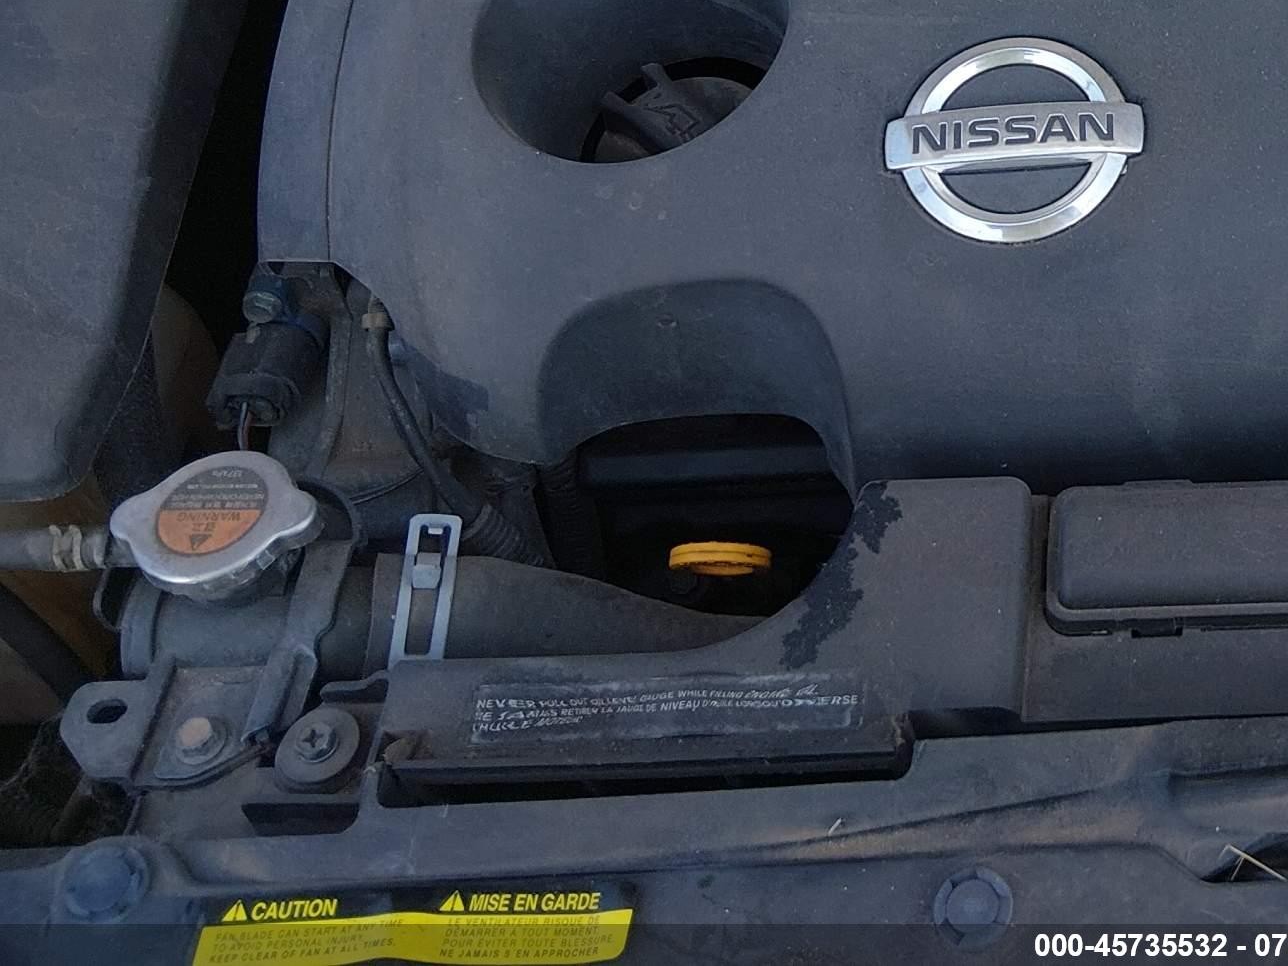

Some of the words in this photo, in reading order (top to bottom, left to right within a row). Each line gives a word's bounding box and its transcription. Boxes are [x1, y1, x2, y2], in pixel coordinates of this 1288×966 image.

[911, 111, 1115, 156] NISSAN
[176, 511, 242, 523] WARNING
[476, 698, 536, 709] NEVER
[569, 698, 589, 706] OUT
[678, 690, 708, 698] WHILE
[660, 699, 700, 712] NIVEAU
[468, 892, 512, 912] MISE
[513, 893, 539, 911] EN
[541, 891, 601, 911] GARDE
[251, 898, 338, 922] CAUTION
[587, 915, 601, 925] DE
[215, 932, 235, 942] FAN
[239, 930, 274, 941] BLADE
[278, 929, 299, 939] CAN
[303, 926, 337, 938] START
[340, 924, 354, 934] AT
[522, 926, 549, 937] TOUT
[213, 942, 226, 953] TO
[229, 940, 263, 952] AVOID
[266, 937, 323, 949] PERSONAL
[442, 937, 473, 948] POUR
[521, 937, 556, 948] TOUTE
[208, 952, 238, 964] KEEP
[241, 950, 277, 962] CLEAR
[280, 949, 296, 960] OF
[299, 947, 320, 958] FAN
[322, 945, 337, 956] AT
[339, 942, 358, 954] ALL
[439, 948, 454, 958] NE
[458, 948, 499, 958] JAMAIS
[533, 946, 599, 958] APPROCHER
